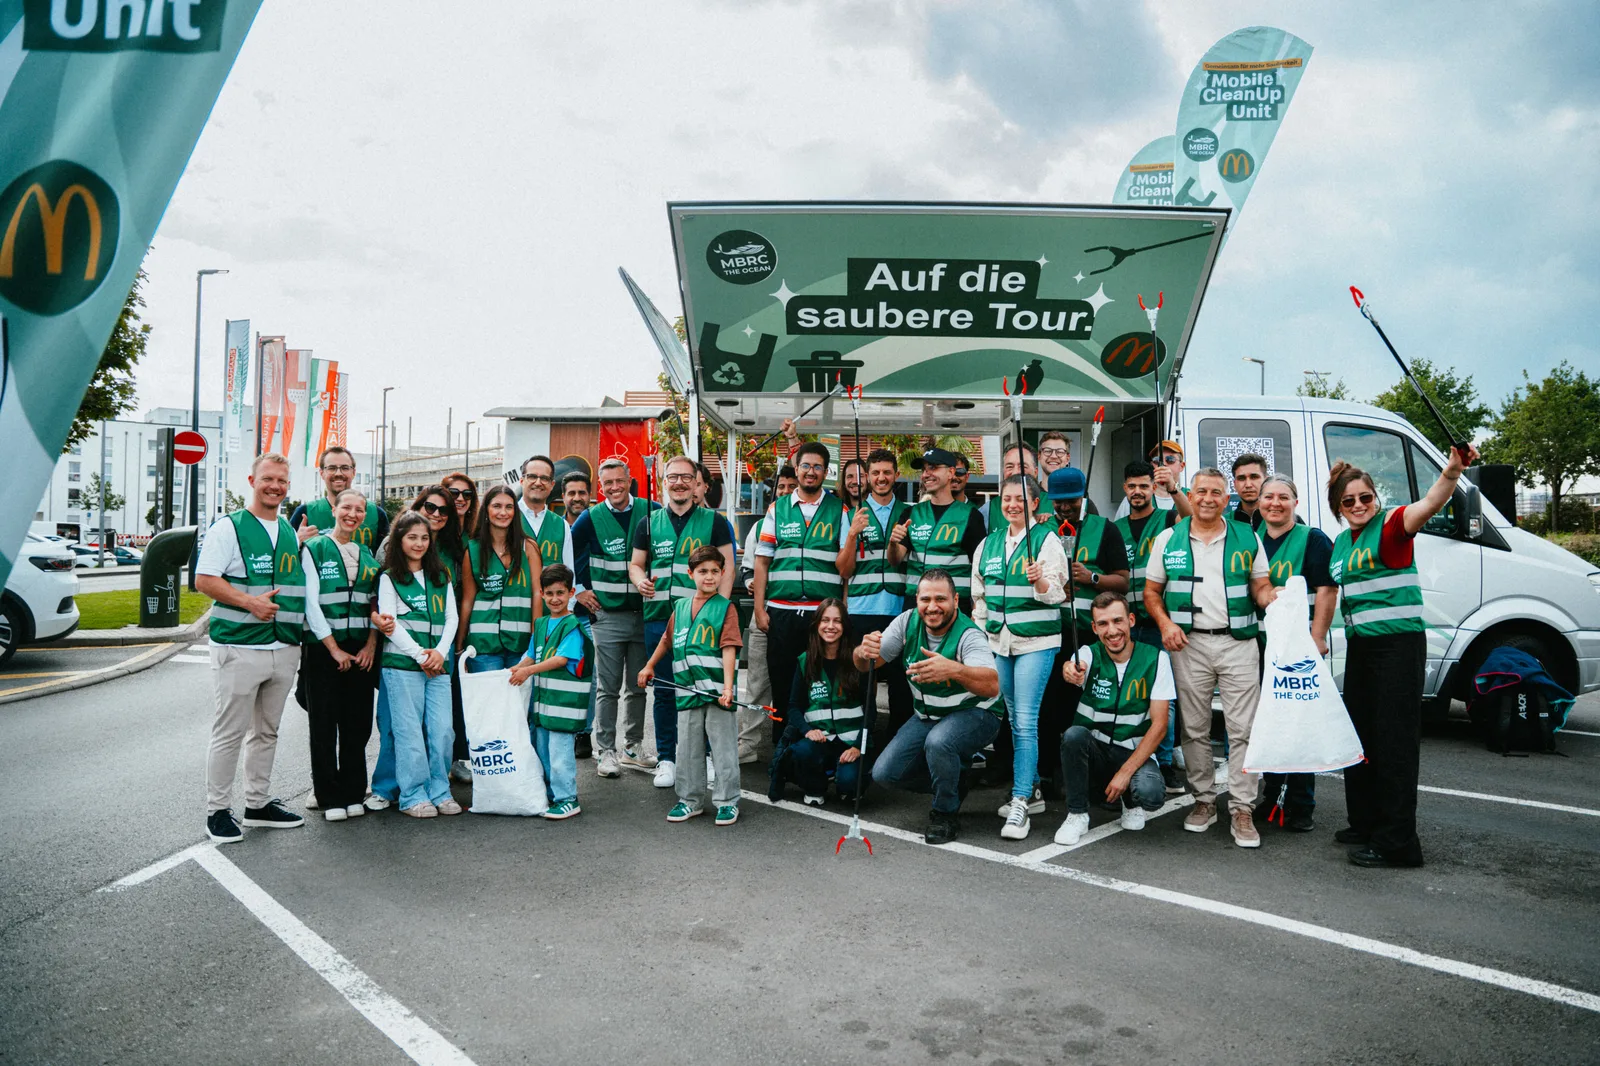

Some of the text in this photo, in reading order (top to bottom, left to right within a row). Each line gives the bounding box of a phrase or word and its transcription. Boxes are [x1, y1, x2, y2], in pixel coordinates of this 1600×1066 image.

[1211, 73, 1274, 87] Mobile
[1203, 87, 1282, 104] CleanUp
[1232, 103, 1272, 118] Unit
[720, 254, 769, 269] MBRC
[724, 265, 771, 276] THE OCEAN
[864, 262, 1026, 293] Auf die
[797, 301, 1093, 331] saubere Tour.
[1273, 674, 1319, 690] MBRC
[1273, 691, 1320, 701] THE OCEA
[471, 752, 514, 767] MBRC
[487, 765, 516, 775] OCEAN
